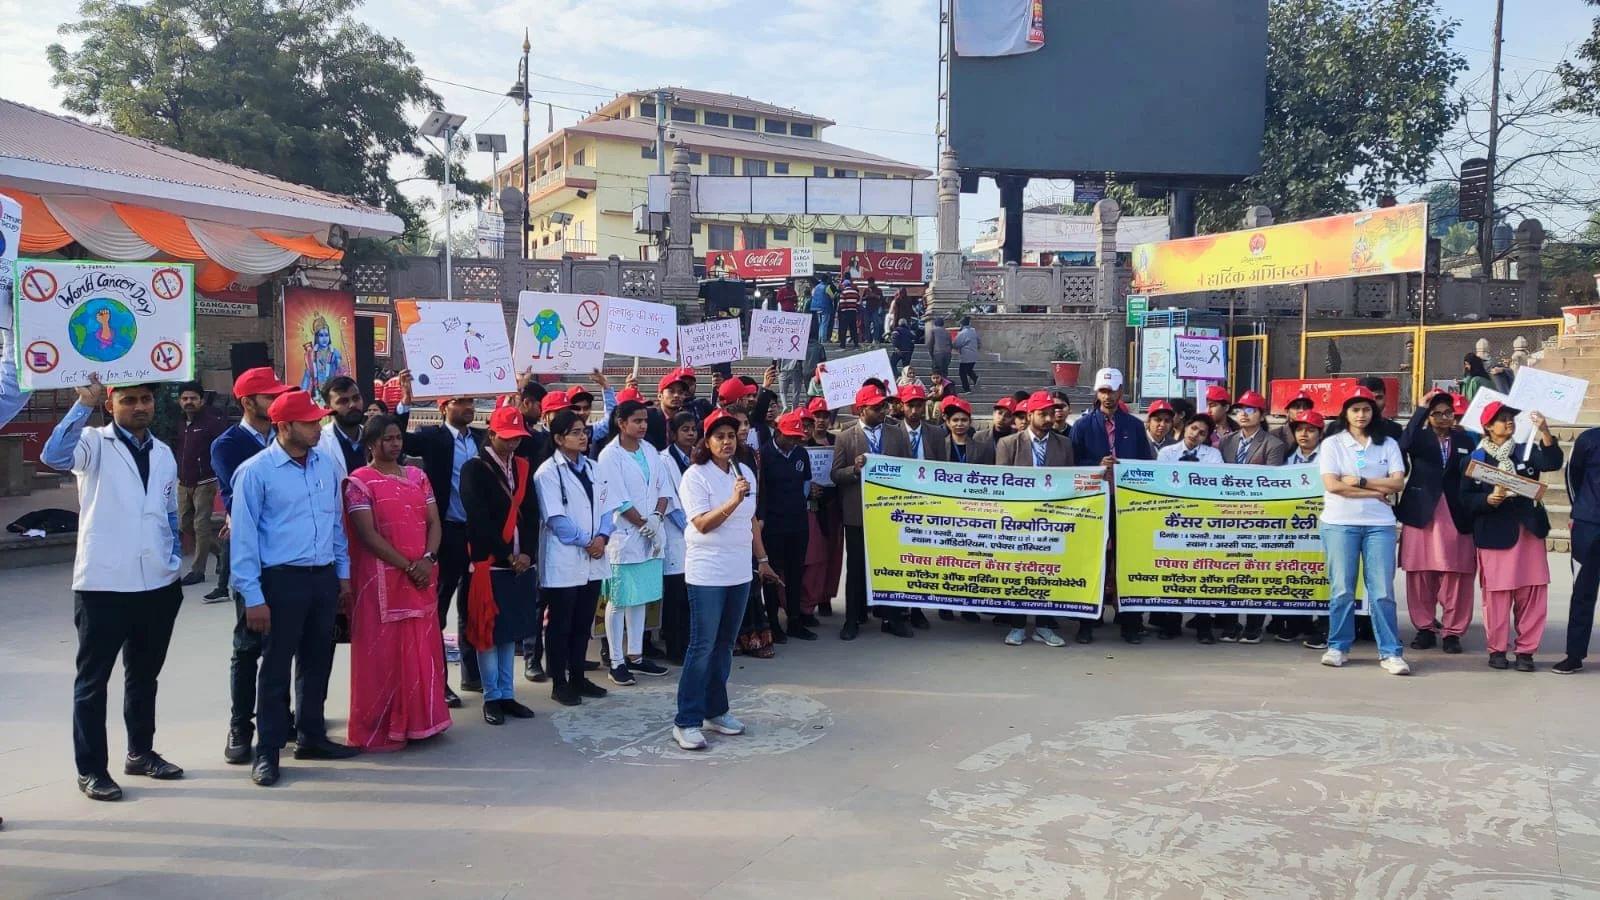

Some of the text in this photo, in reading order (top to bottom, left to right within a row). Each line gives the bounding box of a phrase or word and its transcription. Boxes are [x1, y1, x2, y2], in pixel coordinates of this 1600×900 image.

[1207, 266, 1246, 286] हार्दिक
[58, 275, 94, 306] World
[96, 272, 136, 291] Cancer
[130, 286, 152, 315] Day
[576, 329, 596, 338] STOP
[570, 340, 601, 350] SMOKING
[1185, 362, 1198, 374] Day
[60, 370, 78, 383] Get
[878, 463, 902, 473] एपेक्स
[1130, 470, 1155, 478] एपेक्स
[934, 469, 1036, 488] विश्व कैंसर दिवस
[1188, 472, 1292, 488] विश्व कैंसर दिवस
[890, 508, 924, 524] कैंसर
[1002, 516, 1076, 532] सिम्पोजियम
[1165, 512, 1202, 528] कैंसर
[1292, 512, 1318, 529] रैली
[990, 542, 1015, 550] एपेक्स
[1017, 542, 1051, 552] हॉस्पिटल
[1216, 540, 1240, 549] अस्सी
[1260, 541, 1294, 549] वाराणसी
[900, 553, 1062, 576] एपेक्स हॉस्पिटल कैंसर इंस्टीट्यूट
[1154, 558, 1325, 574] एपेक्स हॉस्पिटल कैंसर इंस्टीट्यूट
[874, 567, 1087, 589] एपेक्स कॉलेज ऑफ नर्सिंग एण्ड फिजियोथेरेपी
[1128, 574, 1158, 584] एपेक्स
[1162, 572, 1196, 584] कॉलेज
[1200, 574, 1223, 585] ऑफ
[1226, 574, 1258, 586] नर्सिंग
[1262, 576, 1282, 586] एण्ड
[907, 580, 1051, 600] एपेक्स पैरामेडिकल इंस्टीट्यूट
[1162, 584, 1314, 599] एपेक्स पैरामेडिकल इंस्टीट्यूट
[1022, 600, 1053, 609] वाराणसी
